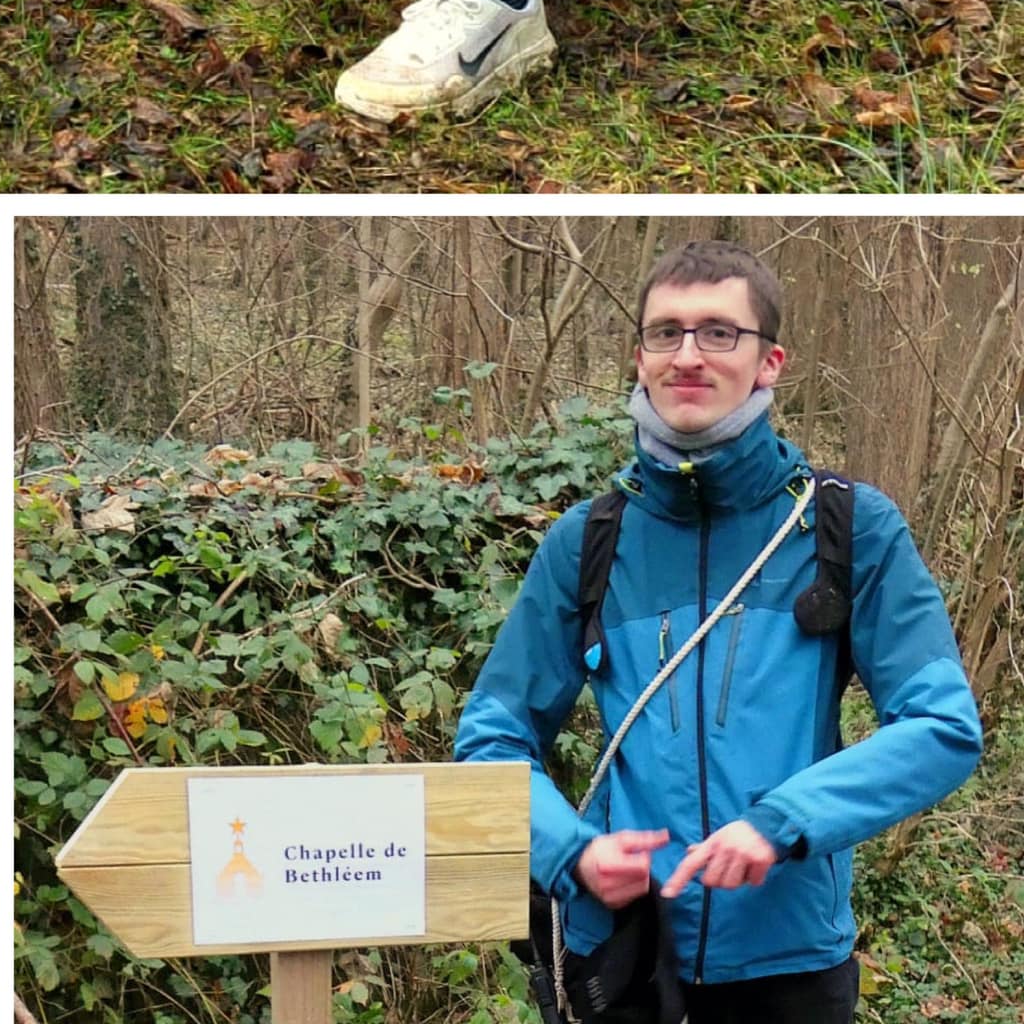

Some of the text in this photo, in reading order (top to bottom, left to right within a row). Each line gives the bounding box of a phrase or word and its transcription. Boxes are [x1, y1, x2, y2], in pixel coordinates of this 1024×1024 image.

[284, 842, 407, 863] Chapelle de
[285, 867, 382, 883] Bethléem
